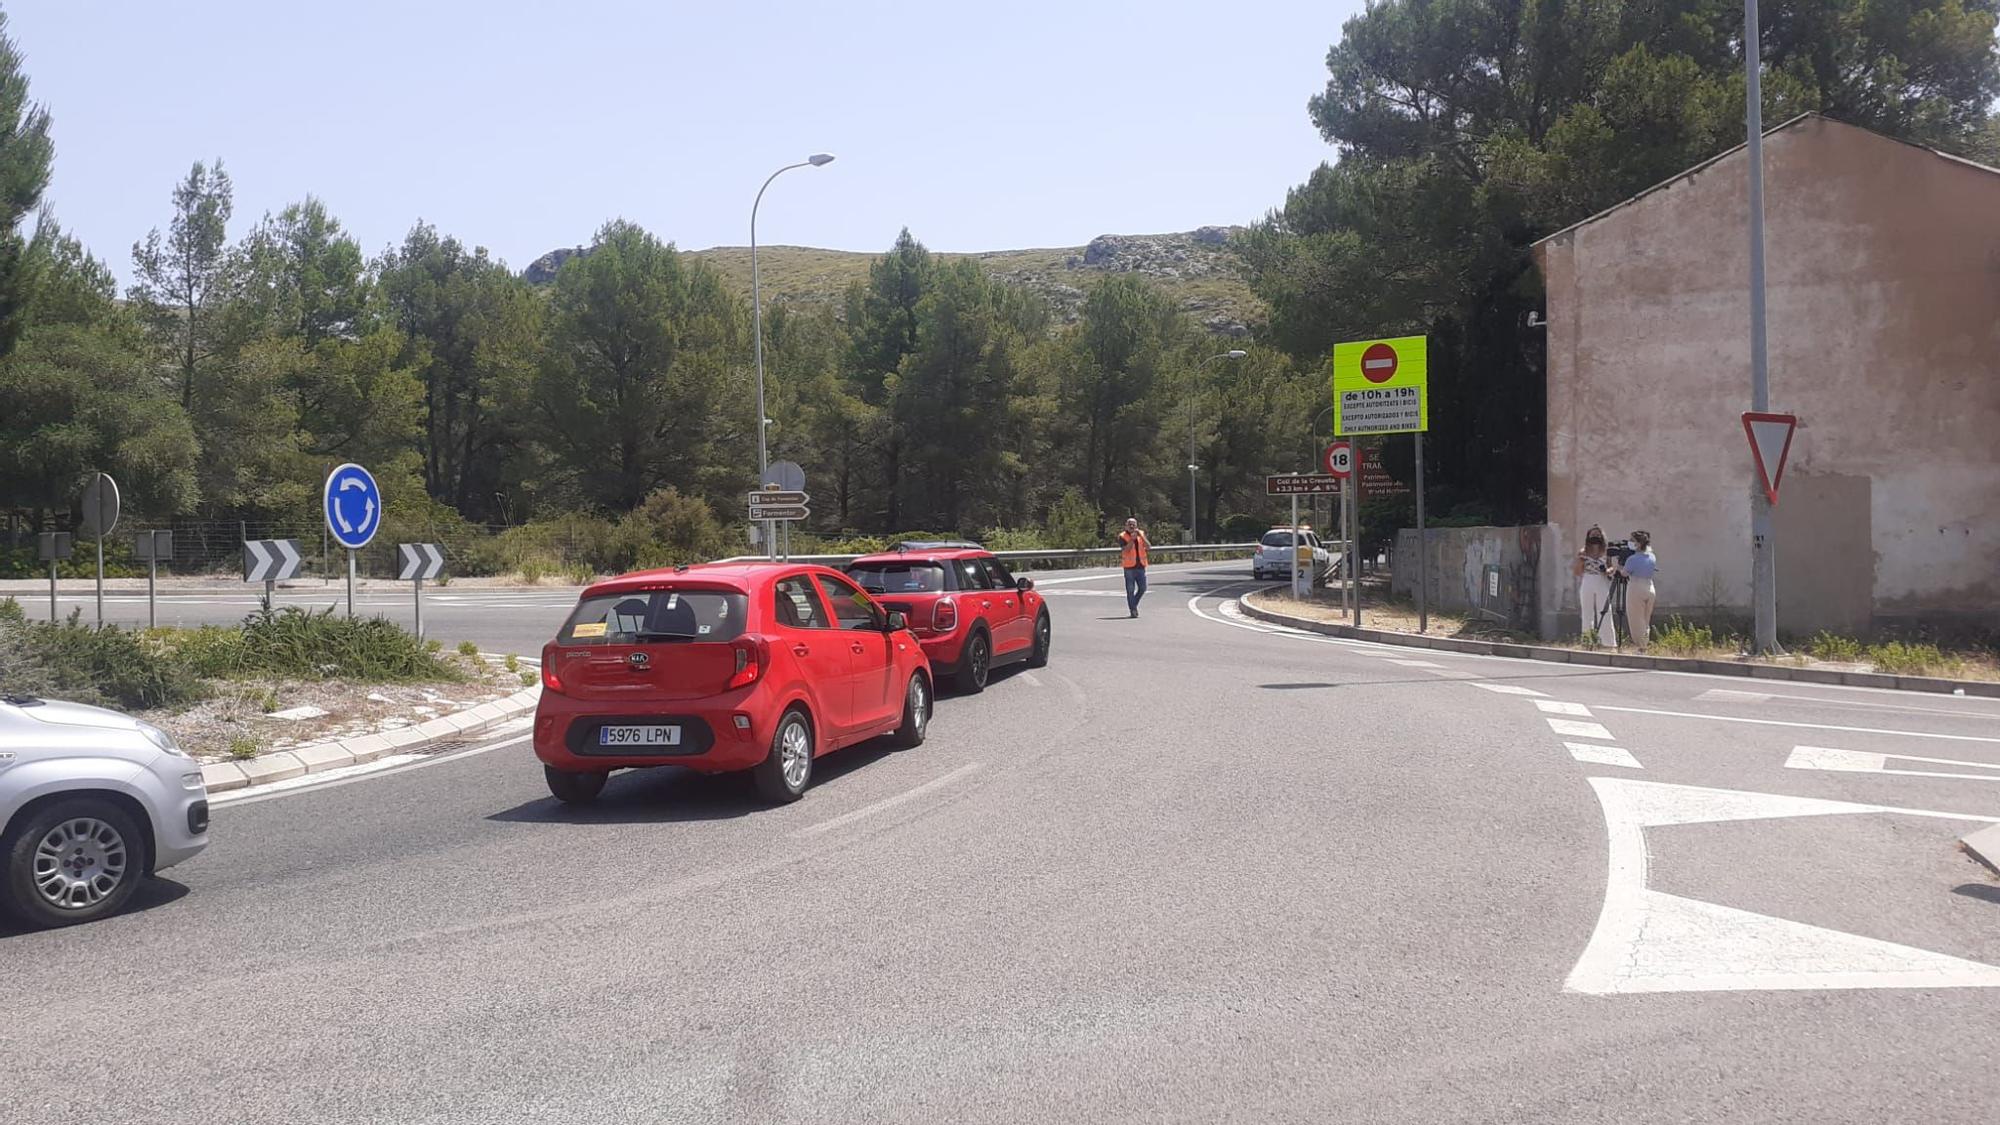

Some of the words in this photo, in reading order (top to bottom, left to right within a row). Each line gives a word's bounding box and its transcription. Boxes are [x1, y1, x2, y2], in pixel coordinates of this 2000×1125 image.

[1345, 392, 1358, 401] de
[1361, 390, 1382, 400] 10h
[1394, 387, 1415, 397] 19h
[1332, 454, 1348, 466] 18
[609, 728, 641, 743] 5976
[646, 728, 672, 743] LPN
